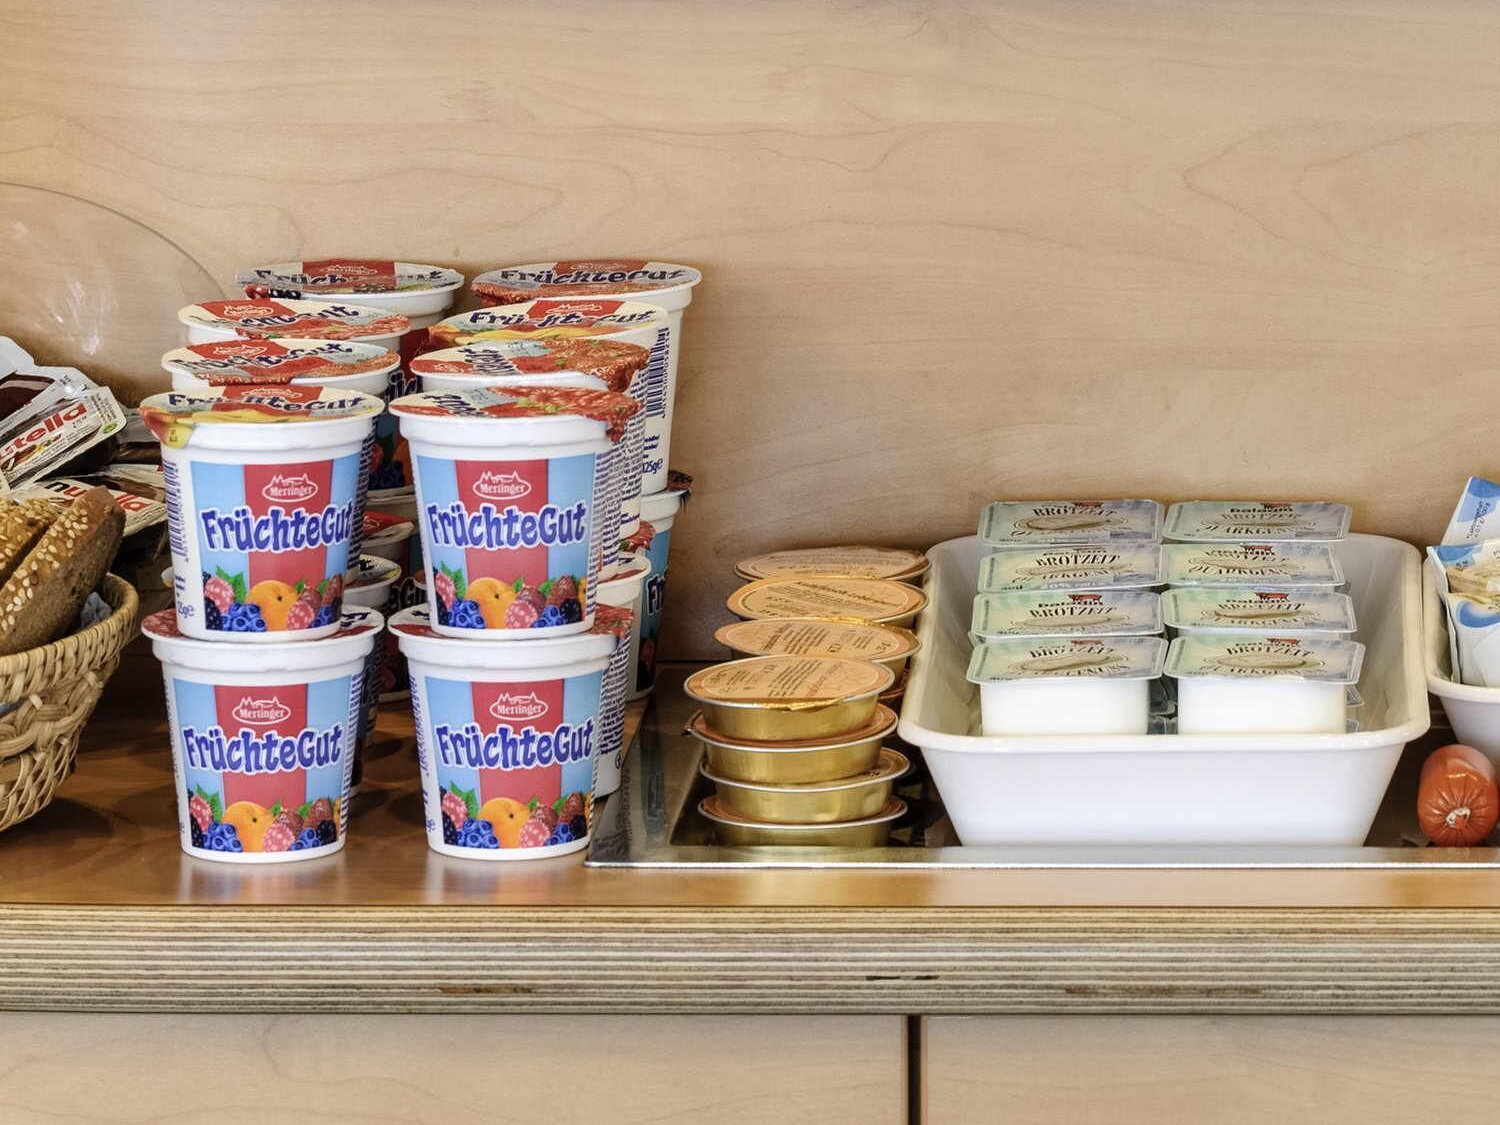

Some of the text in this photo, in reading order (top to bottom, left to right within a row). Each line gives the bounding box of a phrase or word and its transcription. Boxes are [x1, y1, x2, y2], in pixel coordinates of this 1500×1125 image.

[480, 481, 526, 496] Mertinger
[201, 502, 354, 551] FrüchteGut
[427, 502, 587, 548] FrüchteGut
[240, 707, 286, 720] Mertinger
[497, 704, 543, 717] Mertinger
[183, 724, 343, 772] FrüchteGut
[436, 720, 594, 768] FrüchteGut
